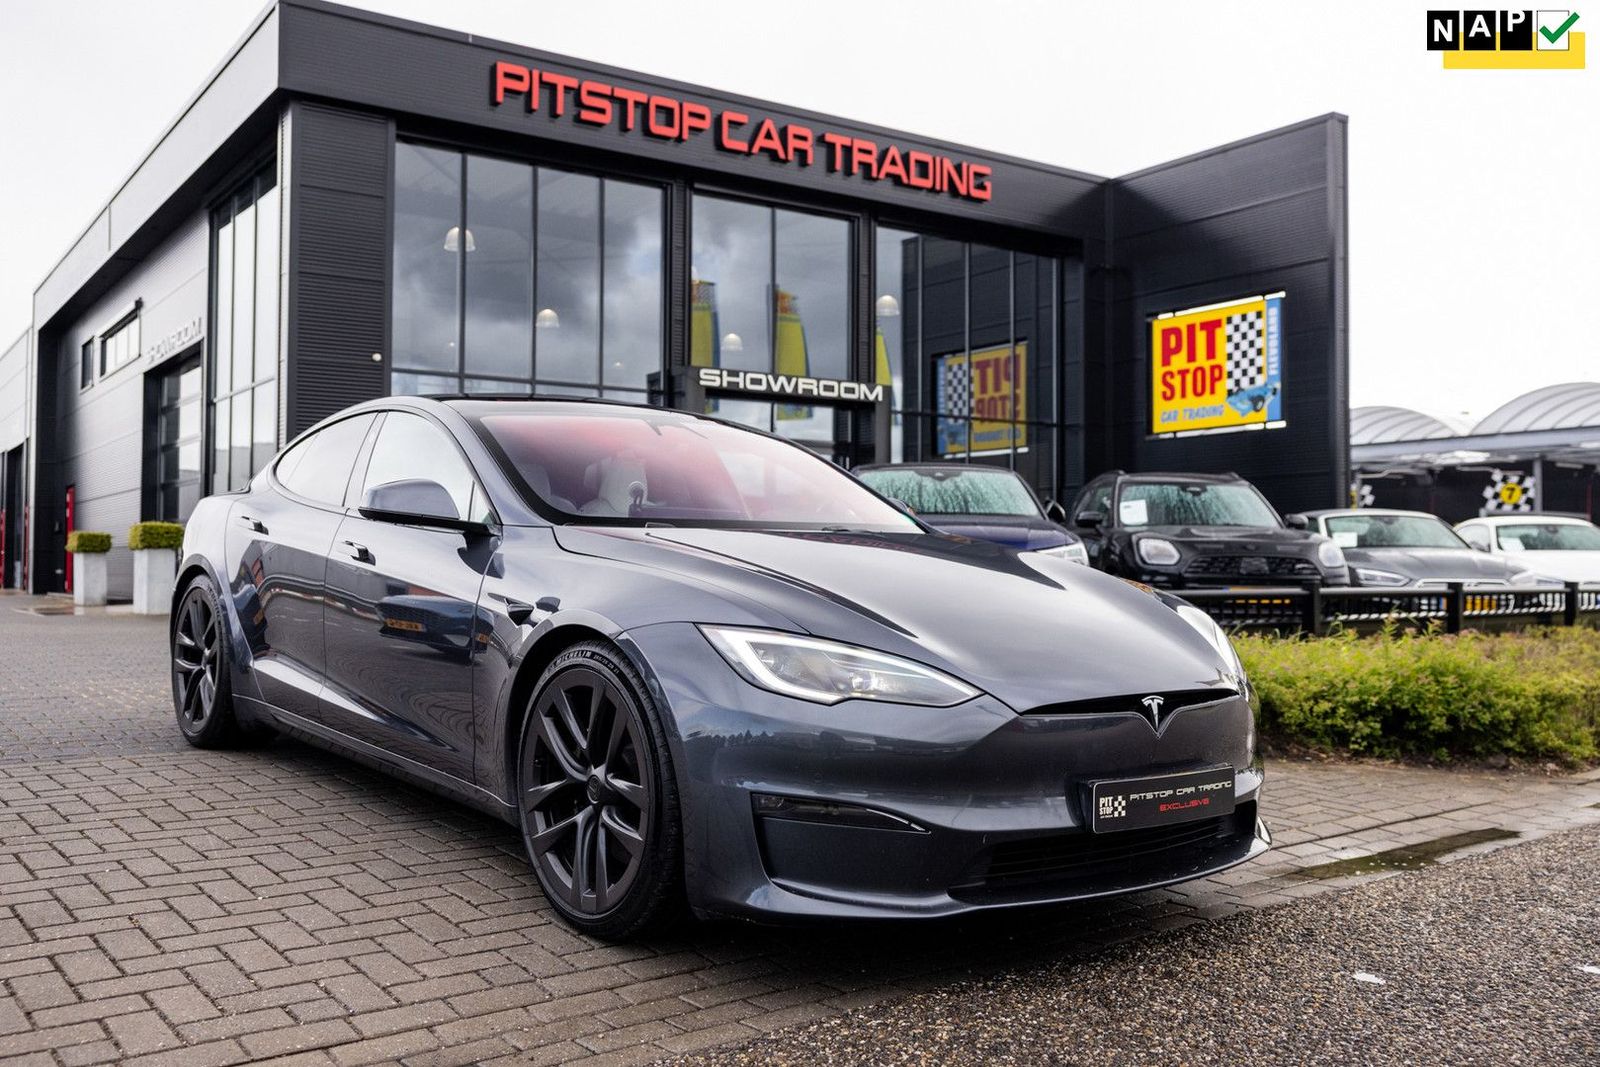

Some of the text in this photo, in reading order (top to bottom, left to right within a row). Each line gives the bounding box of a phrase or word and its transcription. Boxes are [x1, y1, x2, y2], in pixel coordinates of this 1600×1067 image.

[494, 61, 992, 202] PITSTOP CAR TRADING
[1161, 318, 1222, 367] PIT
[699, 368, 884, 402] SHOWROOM
[1161, 364, 1223, 402] STOP
[1160, 403, 1225, 423] CAR TRADING
[1506, 487, 1516, 499] 7
[1129, 780, 1232, 801] PITSTOP CAR TRADING
[1099, 796, 1114, 808] PIT
[1099, 806, 1114, 816] STOP
[1159, 798, 1210, 812] EXCLUSIVE
